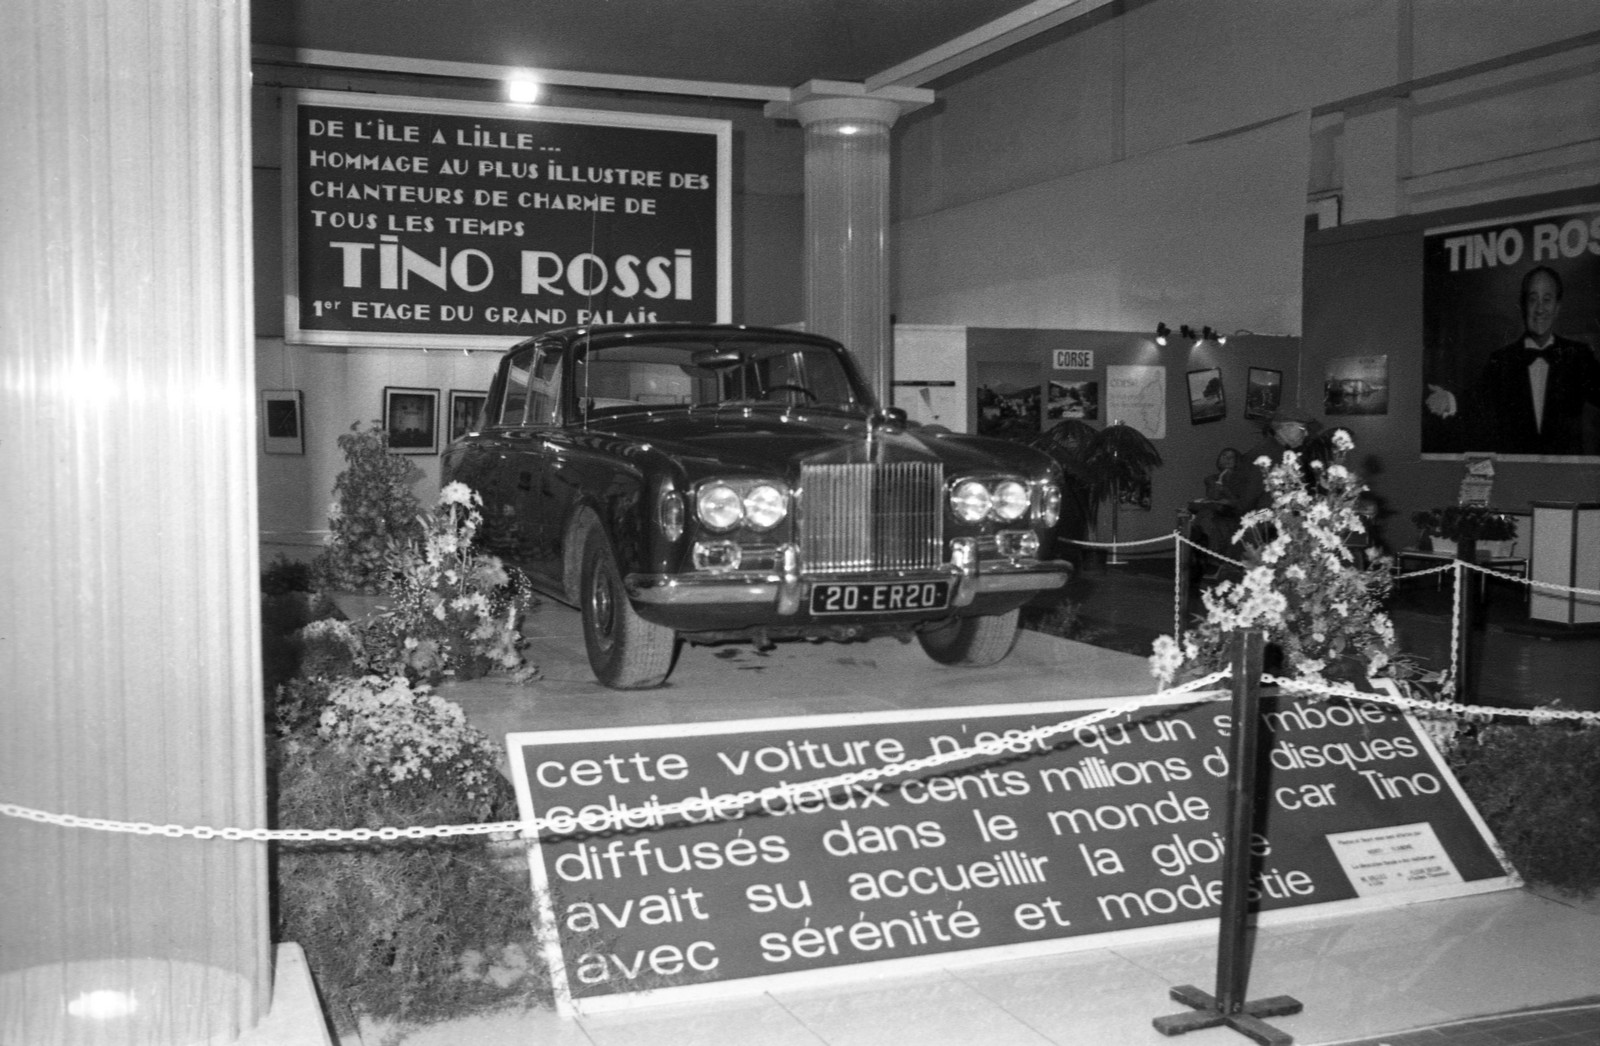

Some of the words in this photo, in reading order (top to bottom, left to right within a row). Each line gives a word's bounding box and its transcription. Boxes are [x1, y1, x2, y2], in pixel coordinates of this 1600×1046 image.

[309, 119, 344, 139] DE
[432, 128, 447, 145] A
[309, 150, 429, 174] HOMMAGE
[440, 160, 469, 176] AU
[479, 161, 539, 180] PLUS
[548, 159, 662, 188] ILLUSTRE
[670, 171, 709, 190] DES
[309, 181, 464, 206] CHANTEURS
[475, 190, 508, 207] DE
[518, 191, 615, 213] CHARME
[625, 198, 656, 216] DE
[312, 210, 378, 230] TOUS
[388, 215, 435, 233] LES
[446, 217, 525, 237] TEMPS
[329, 234, 494, 293] TINO
[521, 248, 692, 301] ROSSI
[1444, 228, 1524, 272] TINO
[352, 301, 430, 321] ETAGE
[440, 306, 473, 323] DU
[485, 307, 567, 325] GRAND
[577, 306, 657, 325] PALAIS
[1057, 352, 1091, 369] CORSE
[536, 752, 689, 788] cette
[717, 738, 905, 776] voiture
[930, 723, 1052, 761] n'est
[1074, 713, 1196, 754] qu'un
[546, 794, 664, 834] celui
[680, 787, 745, 823] de
[760, 781, 890, 817] deux
[900, 770, 1030, 804] cents
[1040, 756, 1192, 793] millions
[1203, 746, 1229, 777] d
[1270, 735, 1419, 771] disques
[555, 829, 790, 882] diffusés
[823, 820, 946, 856] dans
[973, 809, 1018, 843] le
[1047, 791, 1210, 835] monde
[1275, 782, 1336, 810] car
[1358, 769, 1441, 800] Tino
[566, 887, 709, 932] avait
[745, 880, 813, 913] su
[848, 850, 1048, 901] accueillir
[1079, 843, 1125, 877] la
[1152, 832, 1271, 877] gloie
[576, 940, 720, 984] avec
[759, 900, 981, 962] sérénité
[1014, 897, 1071, 931] et
